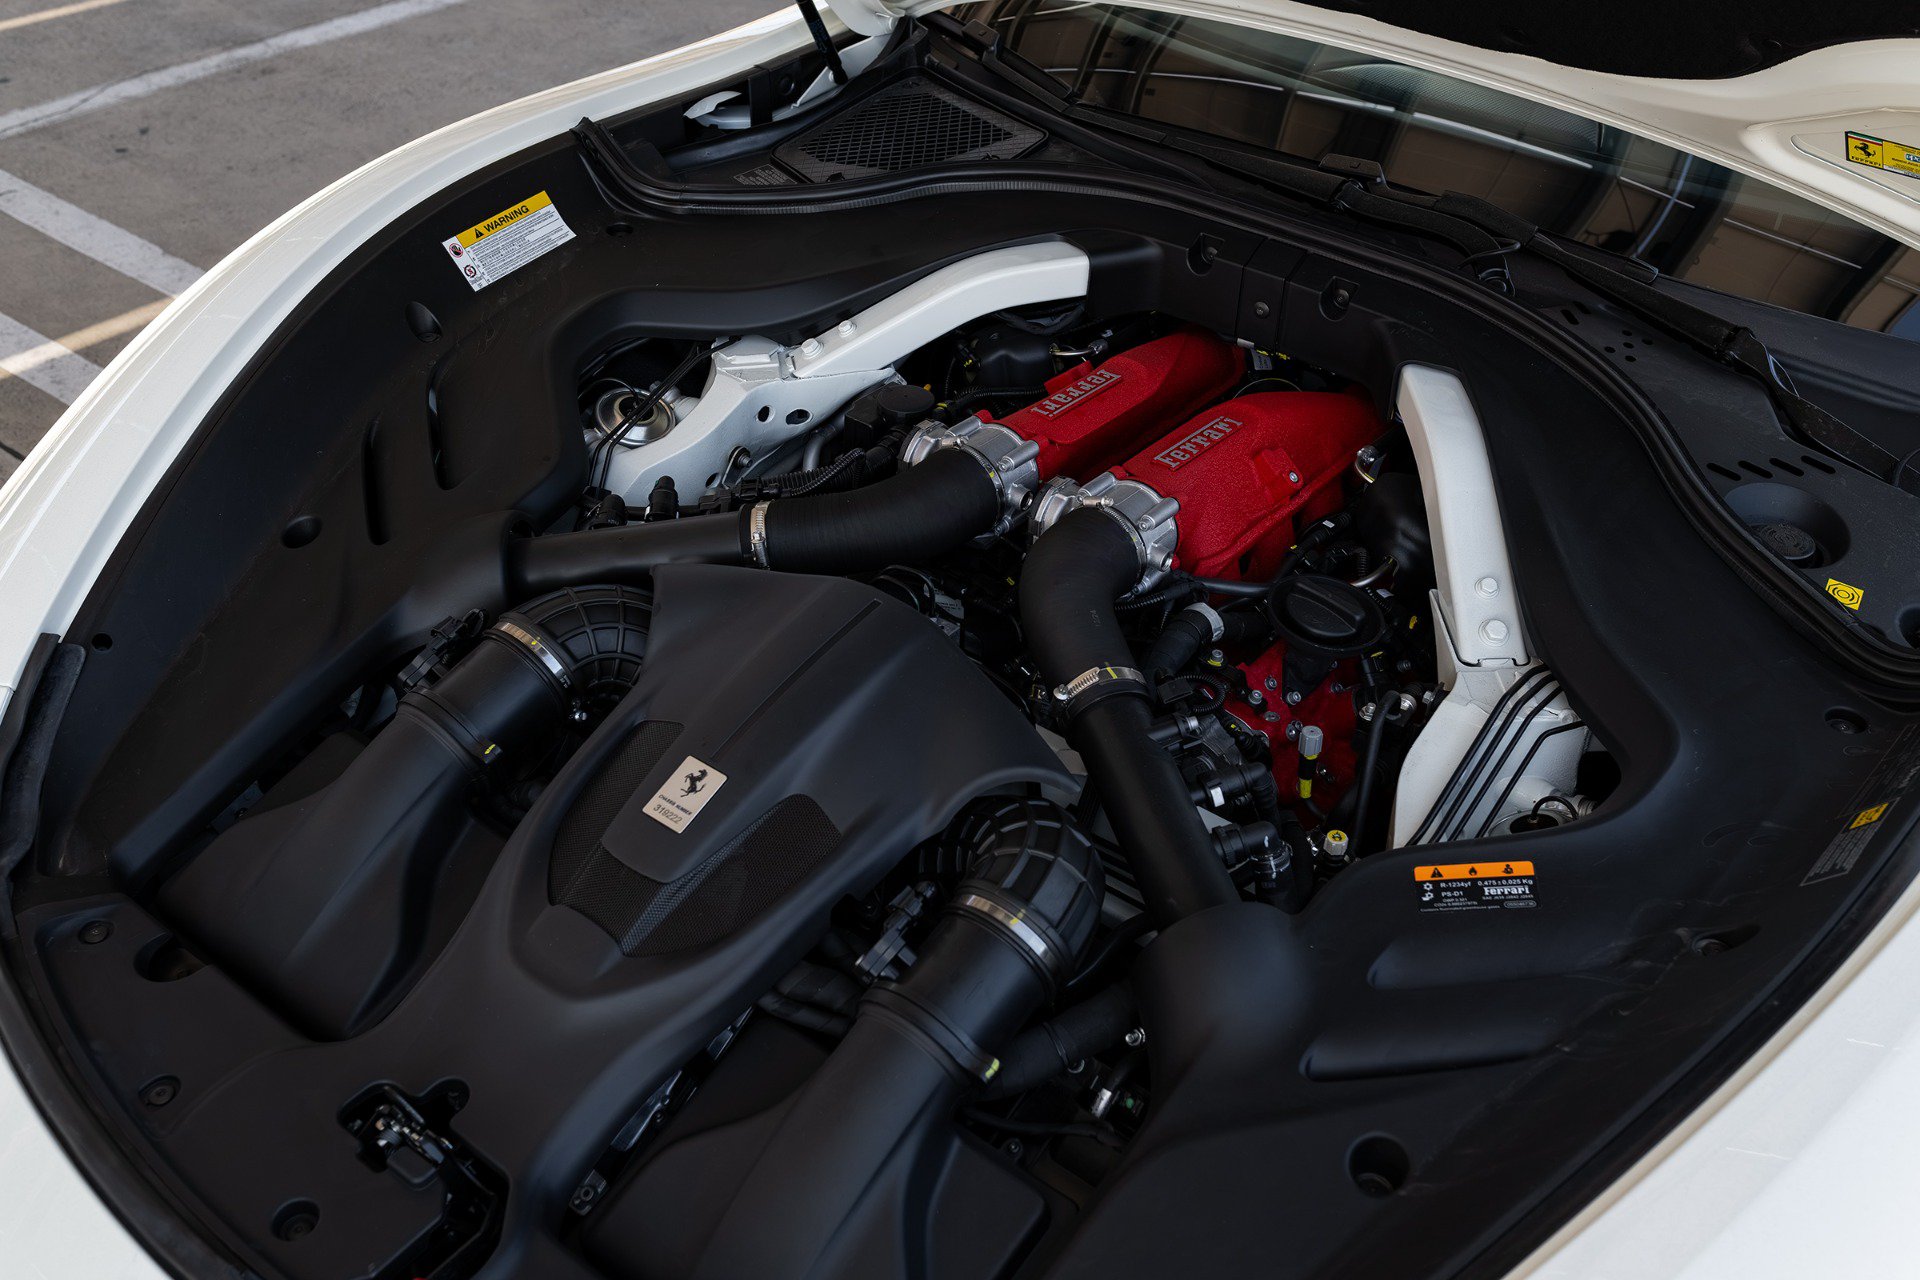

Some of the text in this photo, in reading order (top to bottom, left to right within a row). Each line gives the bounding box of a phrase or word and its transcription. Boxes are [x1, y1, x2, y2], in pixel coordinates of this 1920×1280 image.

[483, 205, 530, 232] WARNING
[1030, 368, 1122, 418] Ferrari
[1153, 415, 1244, 468] Ferrari
[653, 804, 683, 824] 319222
[675, 804, 693, 815] NUMBER
[1439, 881, 1472, 889] R-1234yf
[1482, 885, 1531, 896] Ferrari
[1441, 890, 1464, 898] PS-D1
